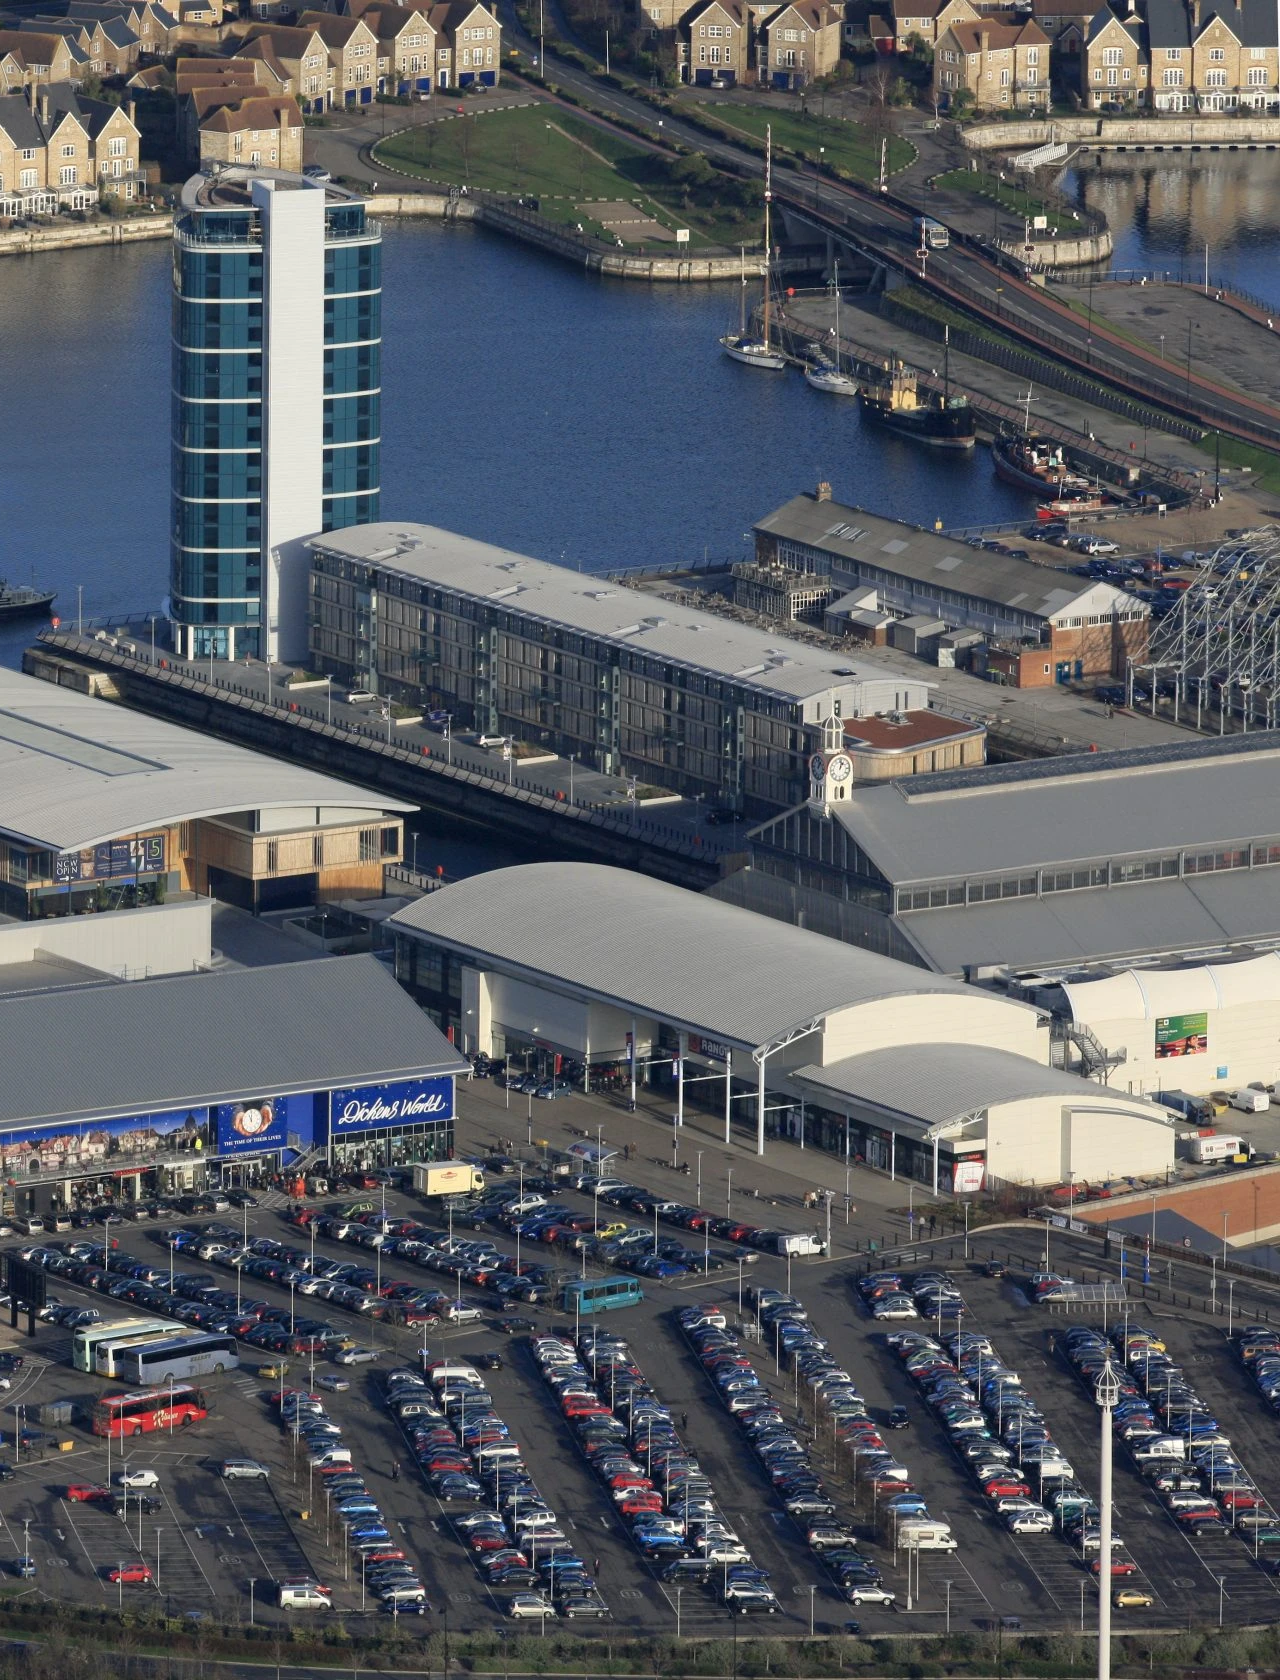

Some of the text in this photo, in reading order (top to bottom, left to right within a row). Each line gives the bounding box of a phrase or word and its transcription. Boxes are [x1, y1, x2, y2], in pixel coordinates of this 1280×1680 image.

[151, 840, 160, 857] 5
[56, 859, 78, 869] NOW
[338, 1093, 446, 1125] Dickens World
